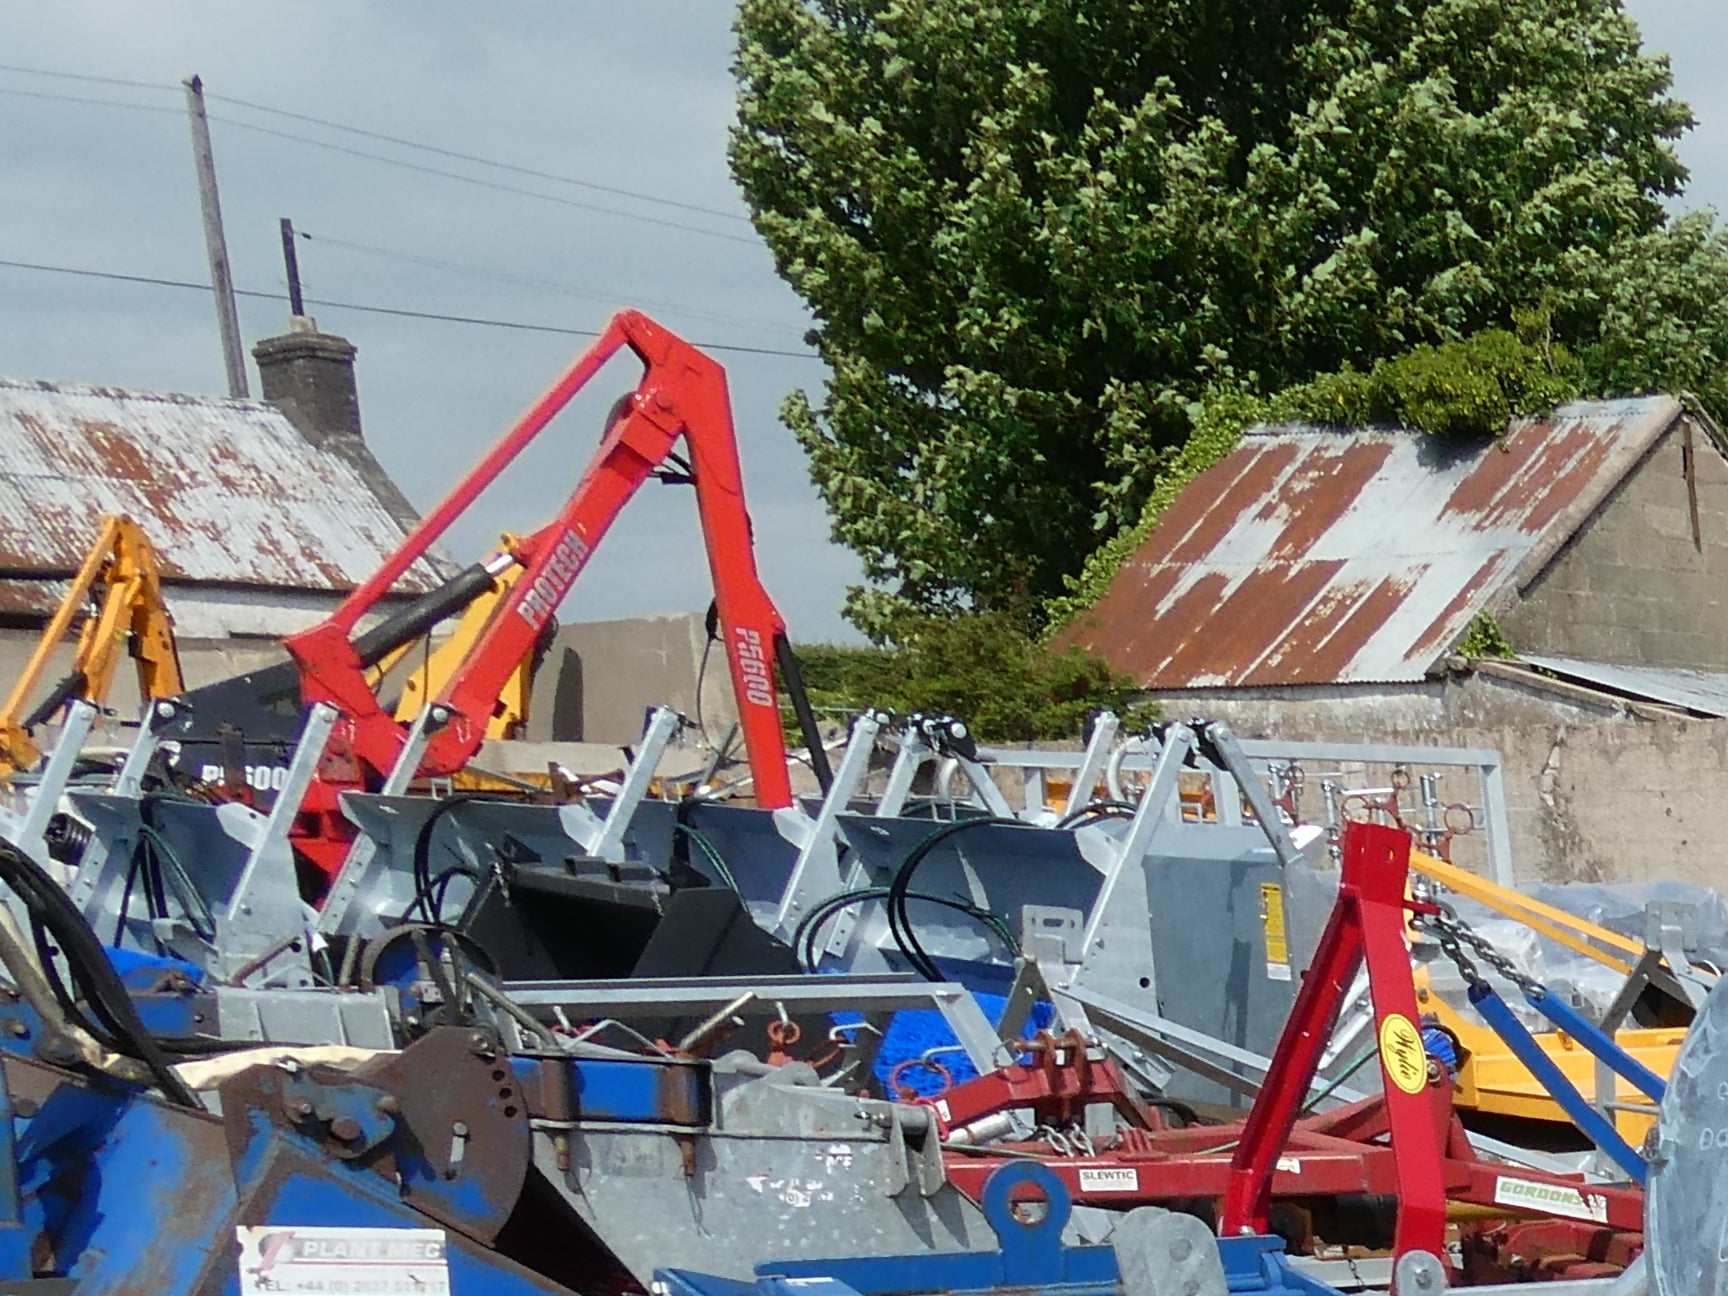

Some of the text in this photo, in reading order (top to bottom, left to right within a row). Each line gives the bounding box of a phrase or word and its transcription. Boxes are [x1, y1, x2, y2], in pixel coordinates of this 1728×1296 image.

[517, 529, 588, 630] PROTECH
[736, 627, 773, 708] PS600
[202, 764, 288, 791] P600
[1386, 1029, 1419, 1080] Wylie
[1082, 1170, 1134, 1180] SLEWTIC
